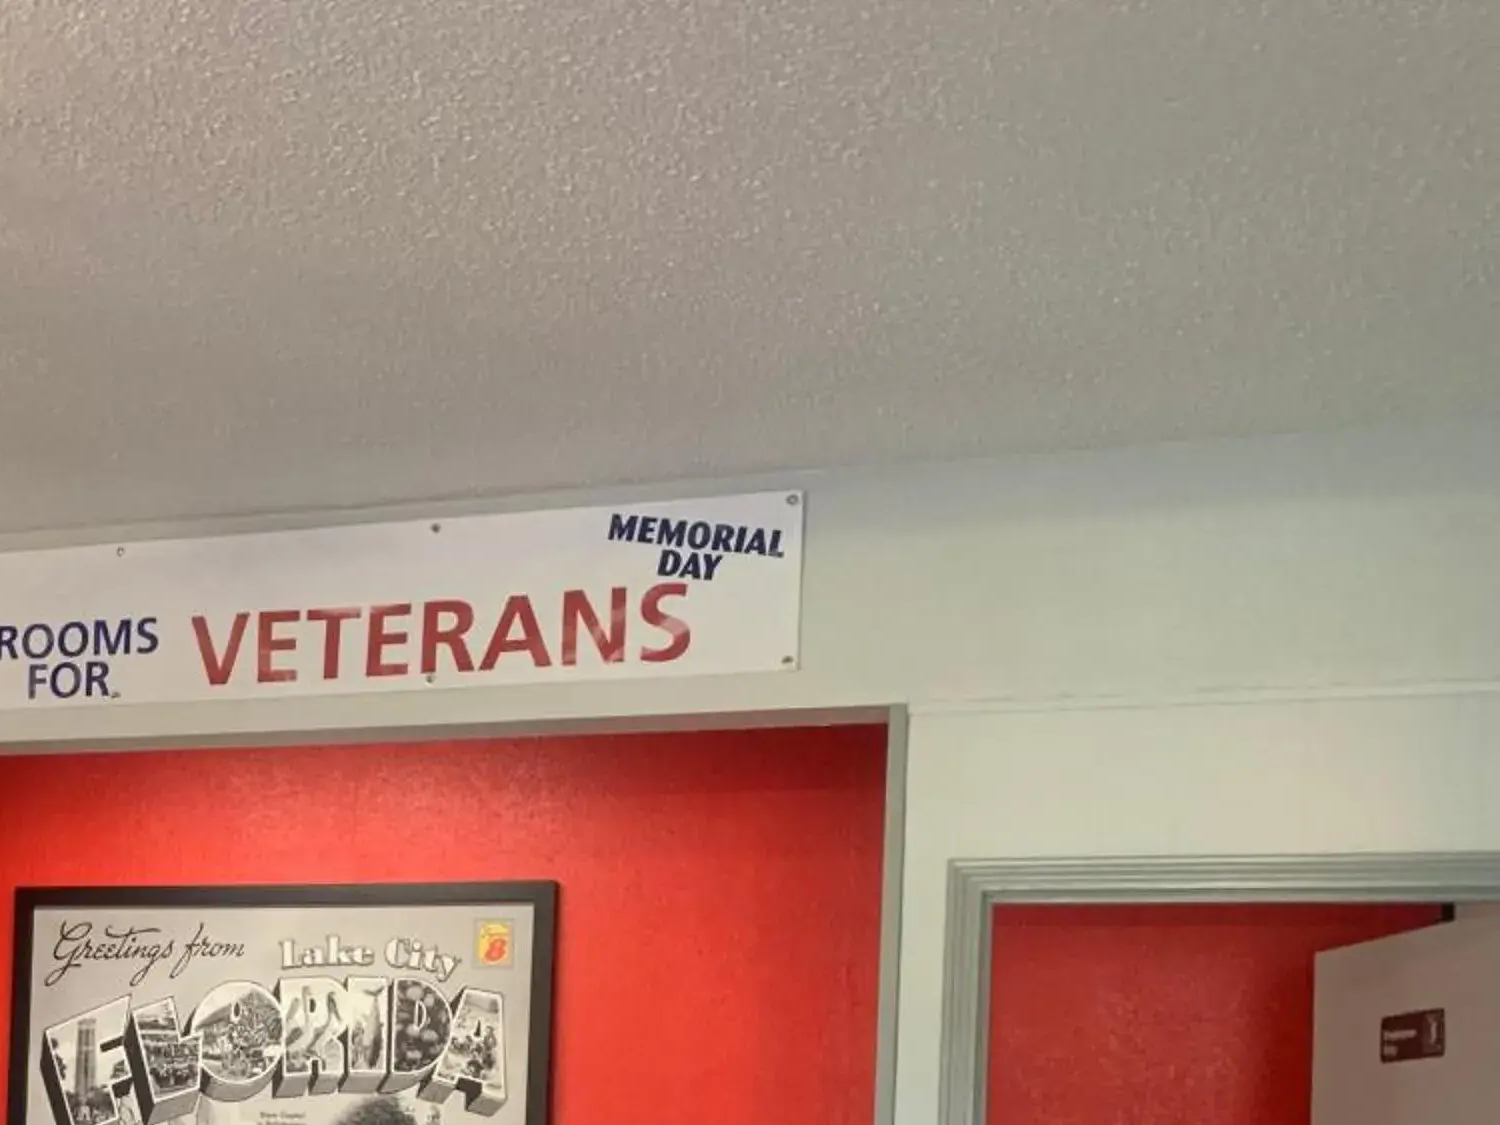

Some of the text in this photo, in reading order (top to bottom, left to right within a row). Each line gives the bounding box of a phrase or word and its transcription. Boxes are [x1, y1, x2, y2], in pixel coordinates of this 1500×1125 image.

[608, 513, 785, 558] MEMORIAL
[657, 549, 723, 581] DAY
[191, 582, 692, 686] VETERANS
[27, 661, 111, 700] FOR
[44, 921, 245, 986] Greetings from
[279, 934, 463, 983] Lake City
